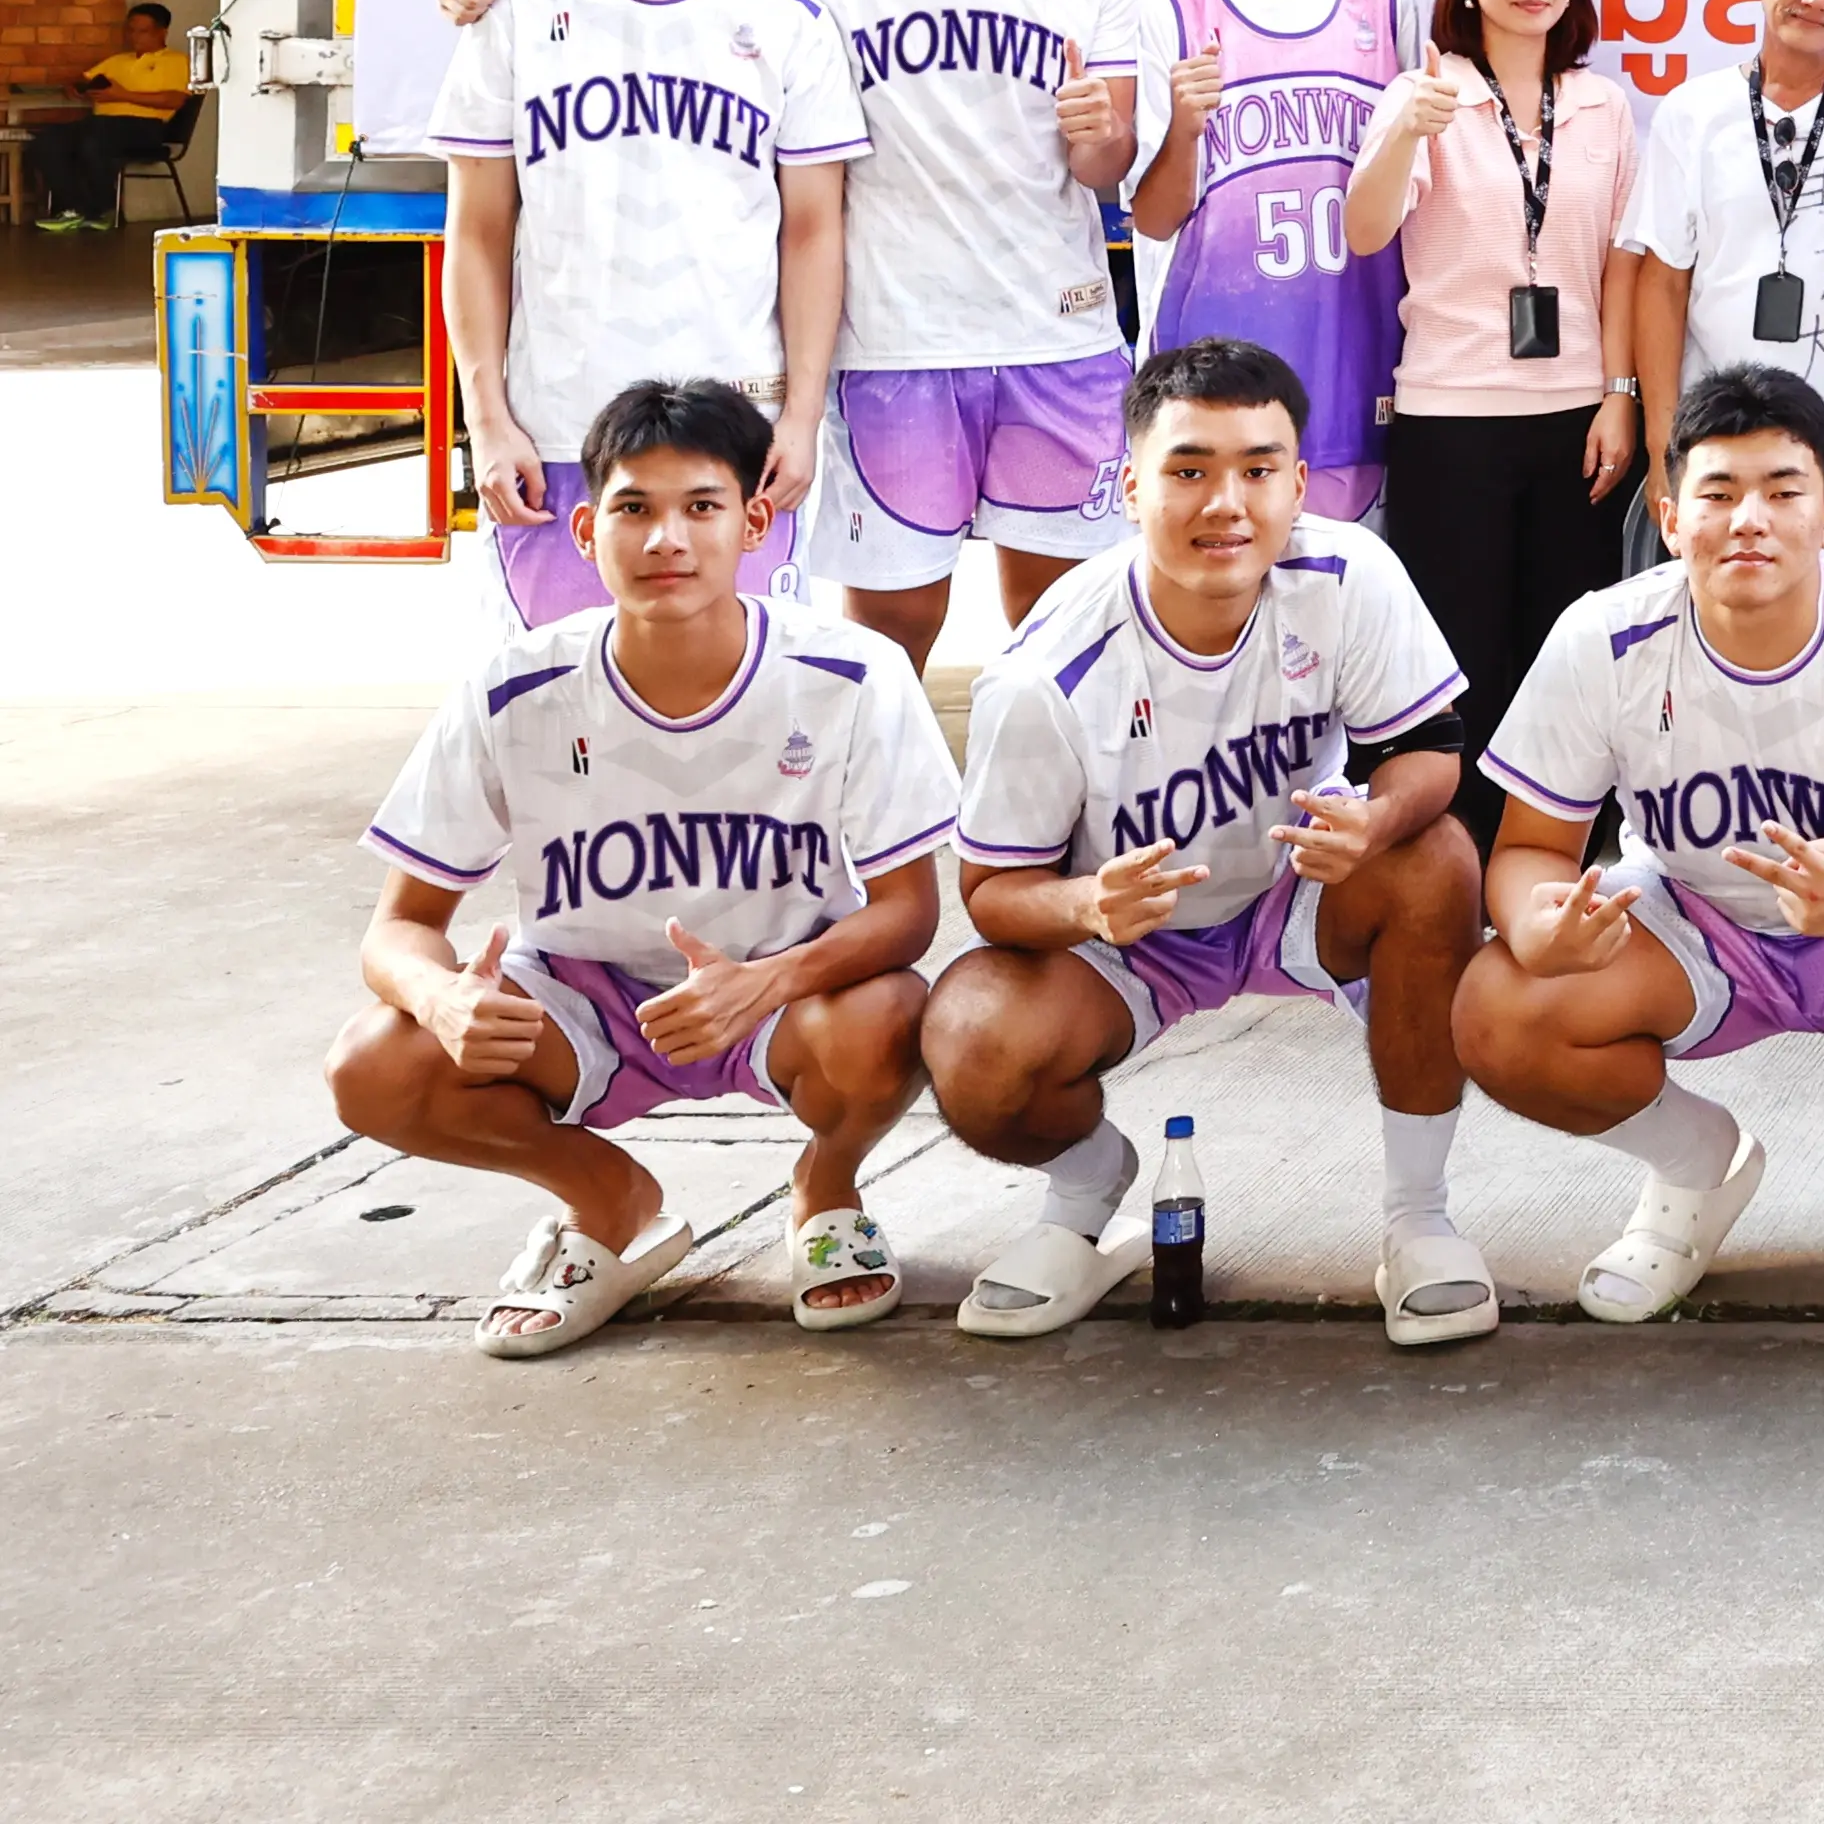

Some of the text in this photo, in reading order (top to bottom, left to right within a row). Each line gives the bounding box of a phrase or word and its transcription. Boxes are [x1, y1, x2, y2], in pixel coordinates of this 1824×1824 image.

[524, 71, 770, 169] NONWIT
[1253, 184, 1350, 281] 50
[536, 811, 830, 921] NONWIT
